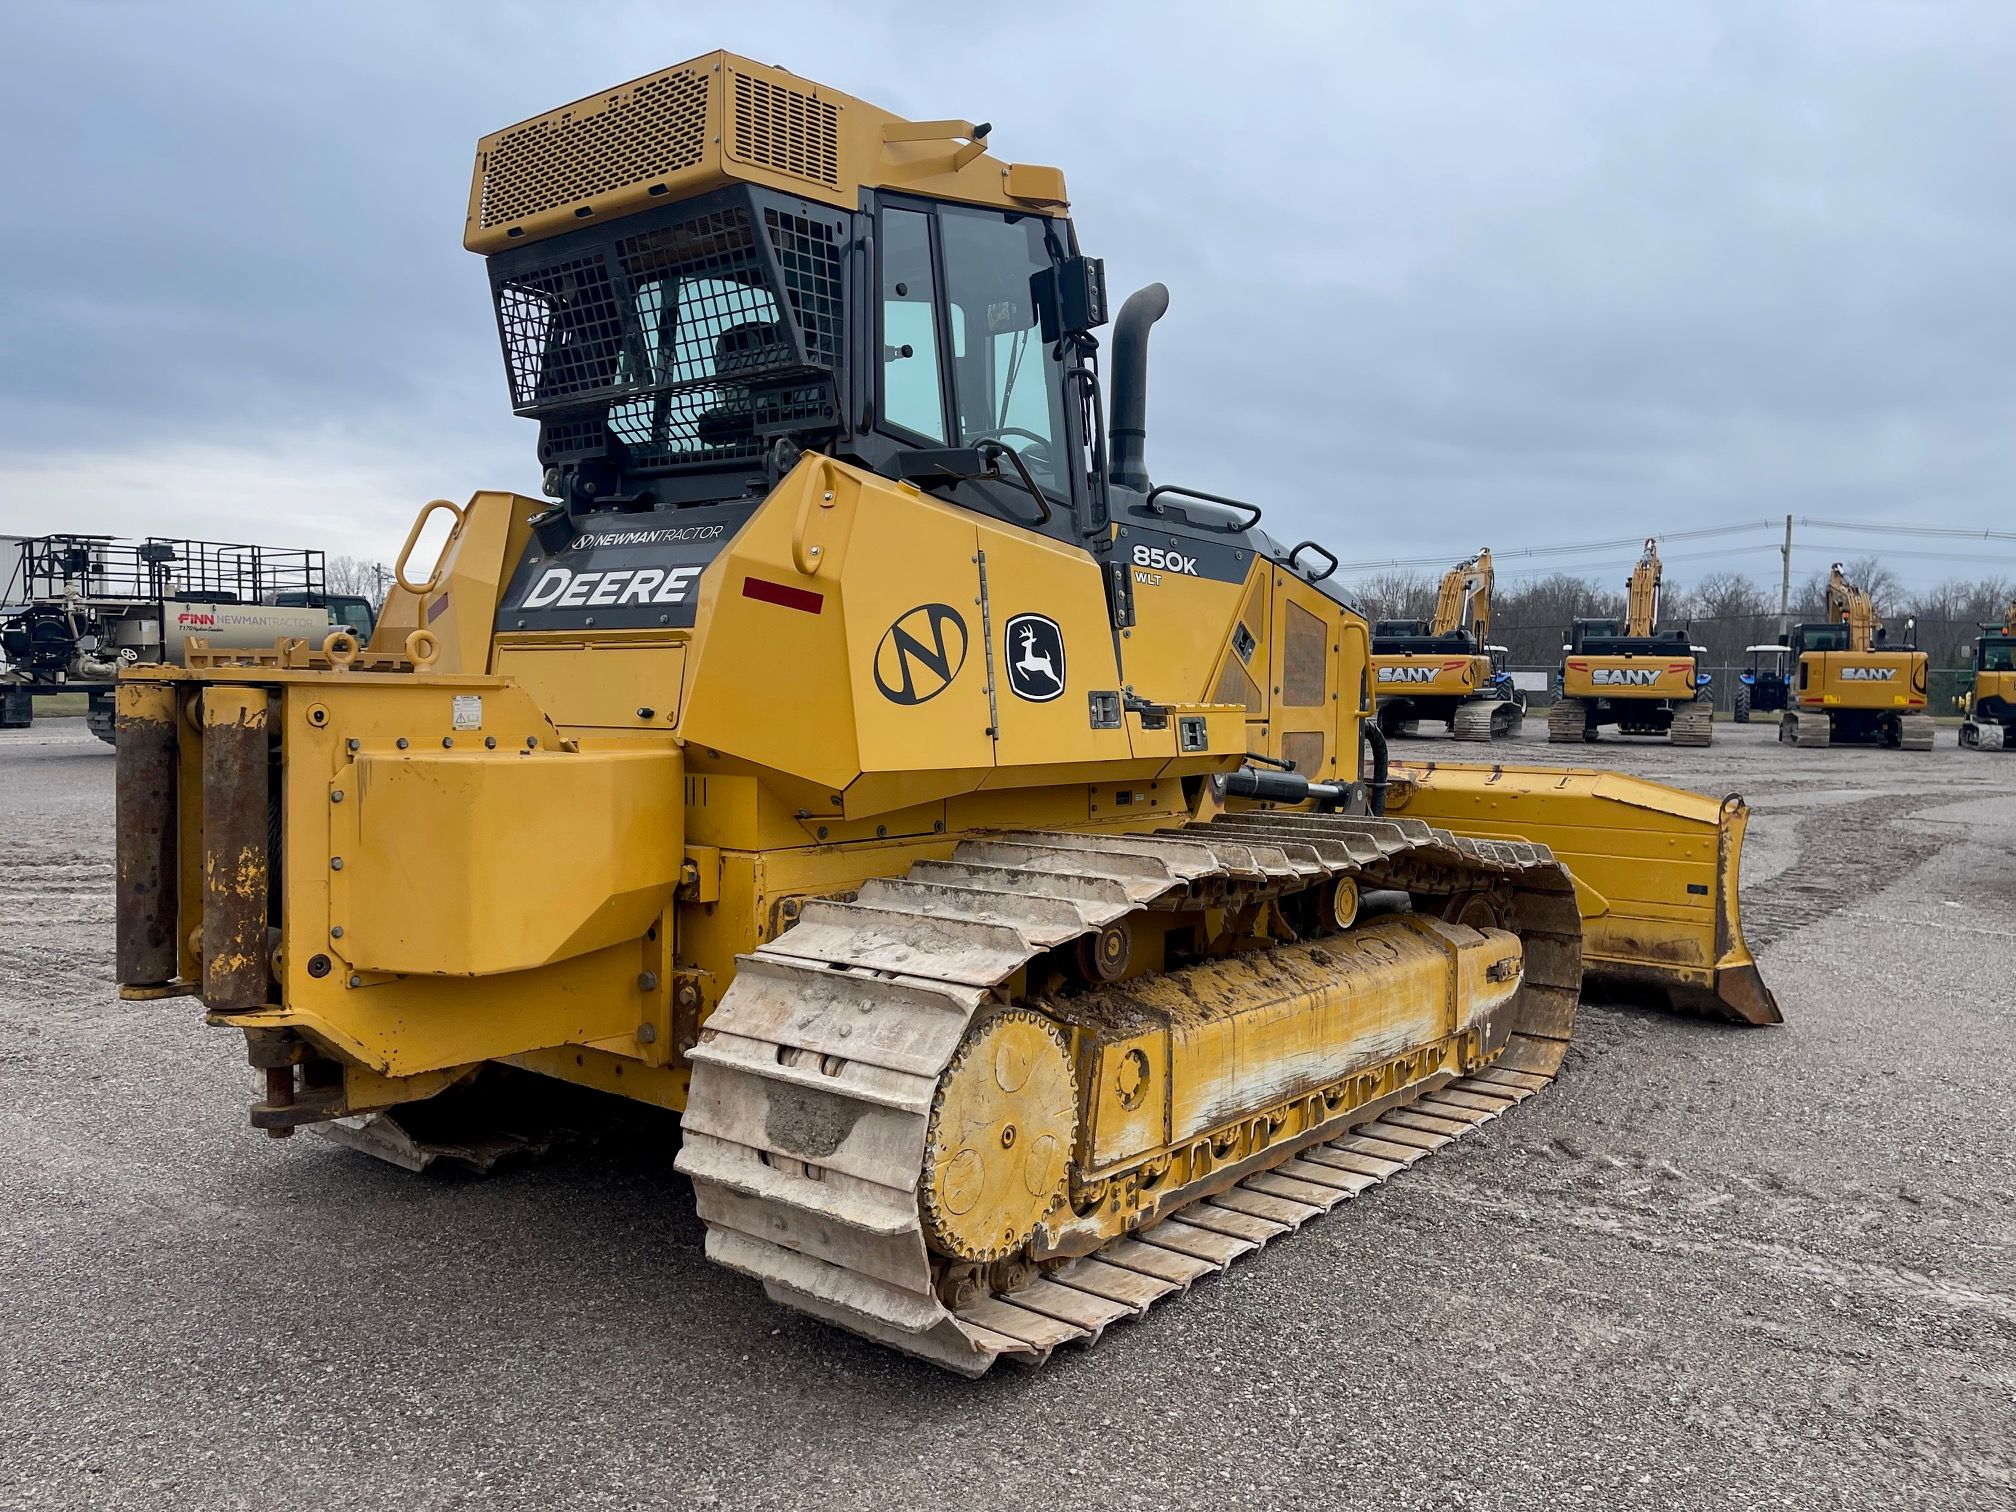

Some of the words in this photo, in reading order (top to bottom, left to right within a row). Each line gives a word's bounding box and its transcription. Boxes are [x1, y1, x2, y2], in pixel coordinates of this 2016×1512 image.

[594, 525, 723, 547] NEWMANTRACTOR
[1133, 544, 1198, 576] 850K
[1134, 571, 1162, 586] WLT
[522, 567, 702, 608] DEERE
[1378, 667, 1441, 683] SANY
[1591, 669, 1662, 685] SANY
[1841, 667, 1898, 681] SANY
